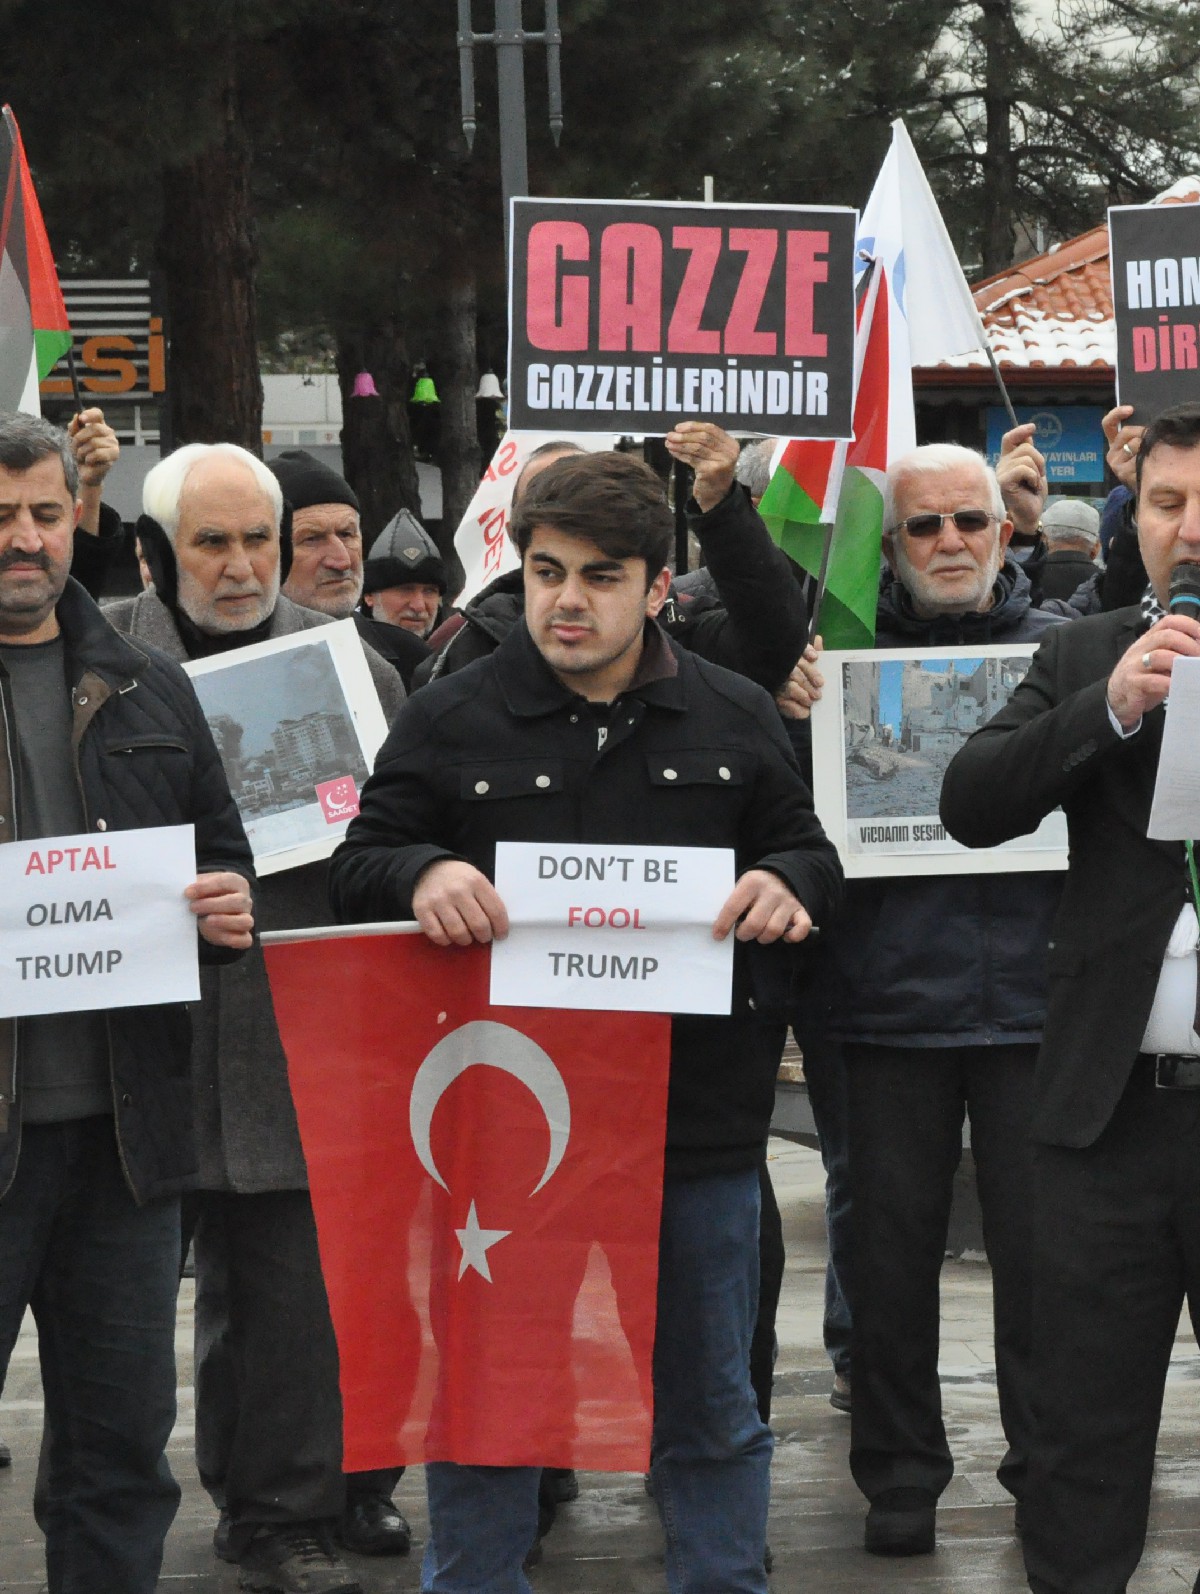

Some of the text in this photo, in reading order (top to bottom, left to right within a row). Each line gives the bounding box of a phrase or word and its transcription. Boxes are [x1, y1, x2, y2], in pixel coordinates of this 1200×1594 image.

[526, 220, 830, 357] GAZZE
[527, 356, 829, 416] GAZZELİLERİNDİR
[328, 804, 358, 818] SAADET
[25, 845, 117, 876] APTAL
[538, 855, 678, 884] DON'T BE
[26, 898, 113, 927] OLMA
[568, 906, 646, 930] FOOL
[15, 950, 122, 981] TRUMP
[548, 952, 659, 981] TRUMP
